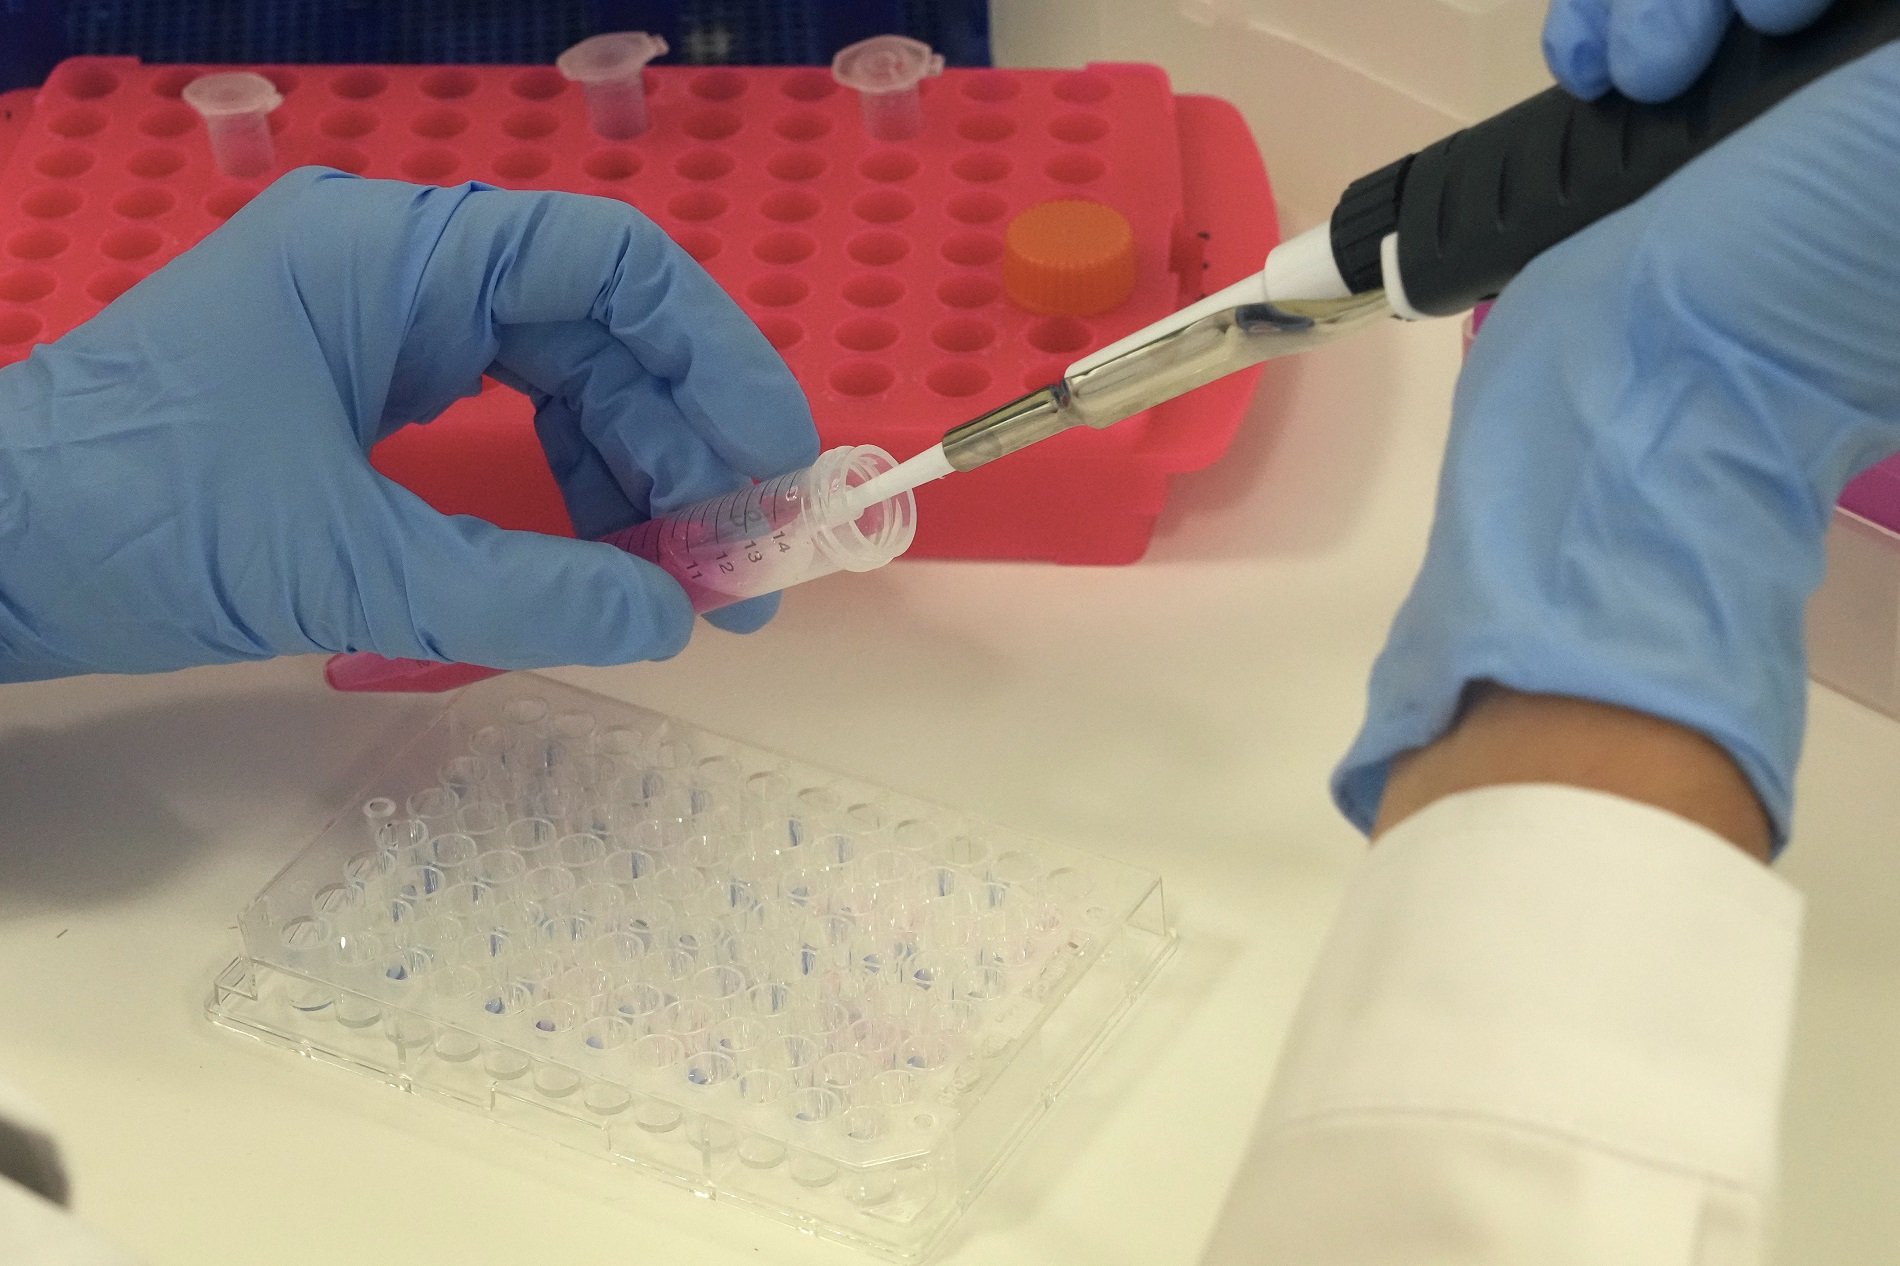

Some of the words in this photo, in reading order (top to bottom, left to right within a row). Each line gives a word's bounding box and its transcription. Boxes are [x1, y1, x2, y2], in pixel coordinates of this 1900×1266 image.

[744, 540, 763, 563] 13
[773, 530, 791, 552] 14
[686, 560, 703, 580] 11
[716, 551, 735, 575] 12
